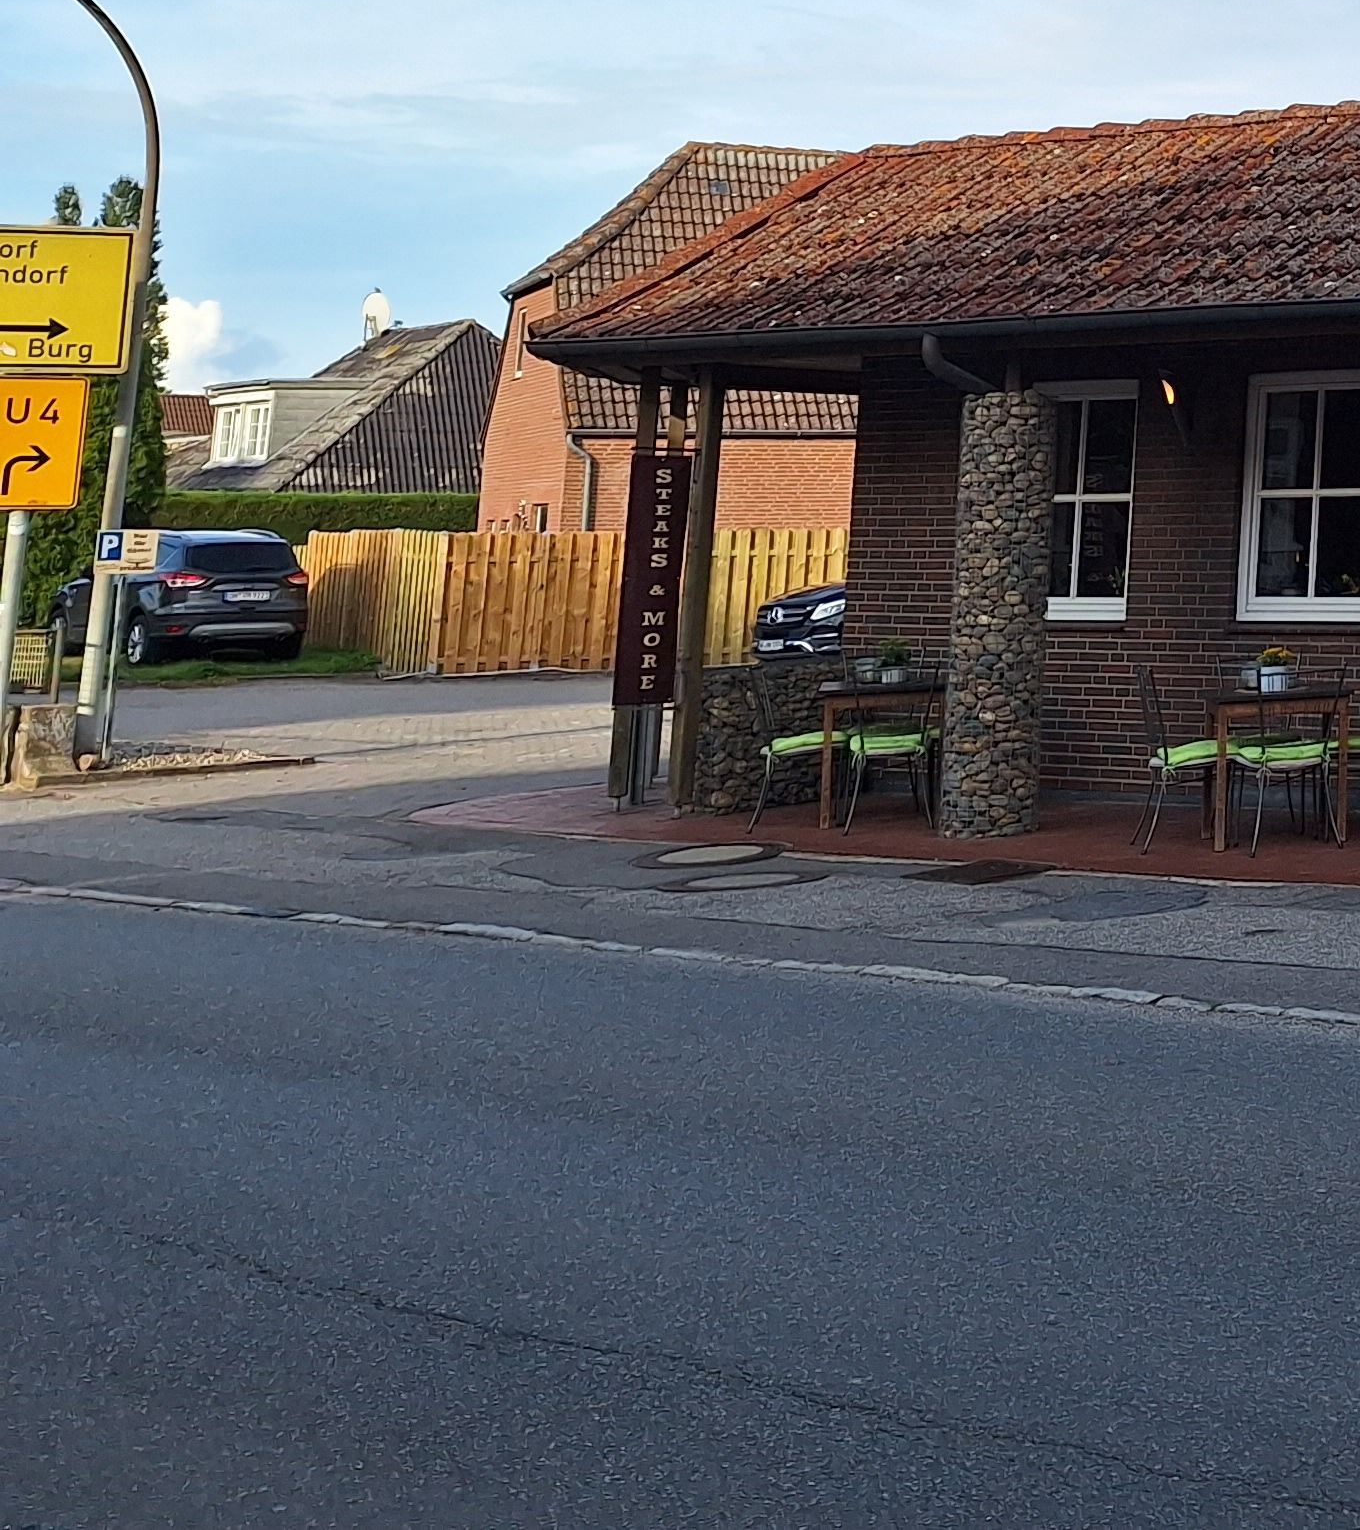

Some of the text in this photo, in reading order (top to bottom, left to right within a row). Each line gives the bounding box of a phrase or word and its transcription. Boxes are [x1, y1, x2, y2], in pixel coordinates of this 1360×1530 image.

[0, 240, 39, 259] orf
[0, 265, 69, 284] ndorf
[28, 338, 93, 363] Burg
[640, 469, 673, 690] STEAKS & MORE
